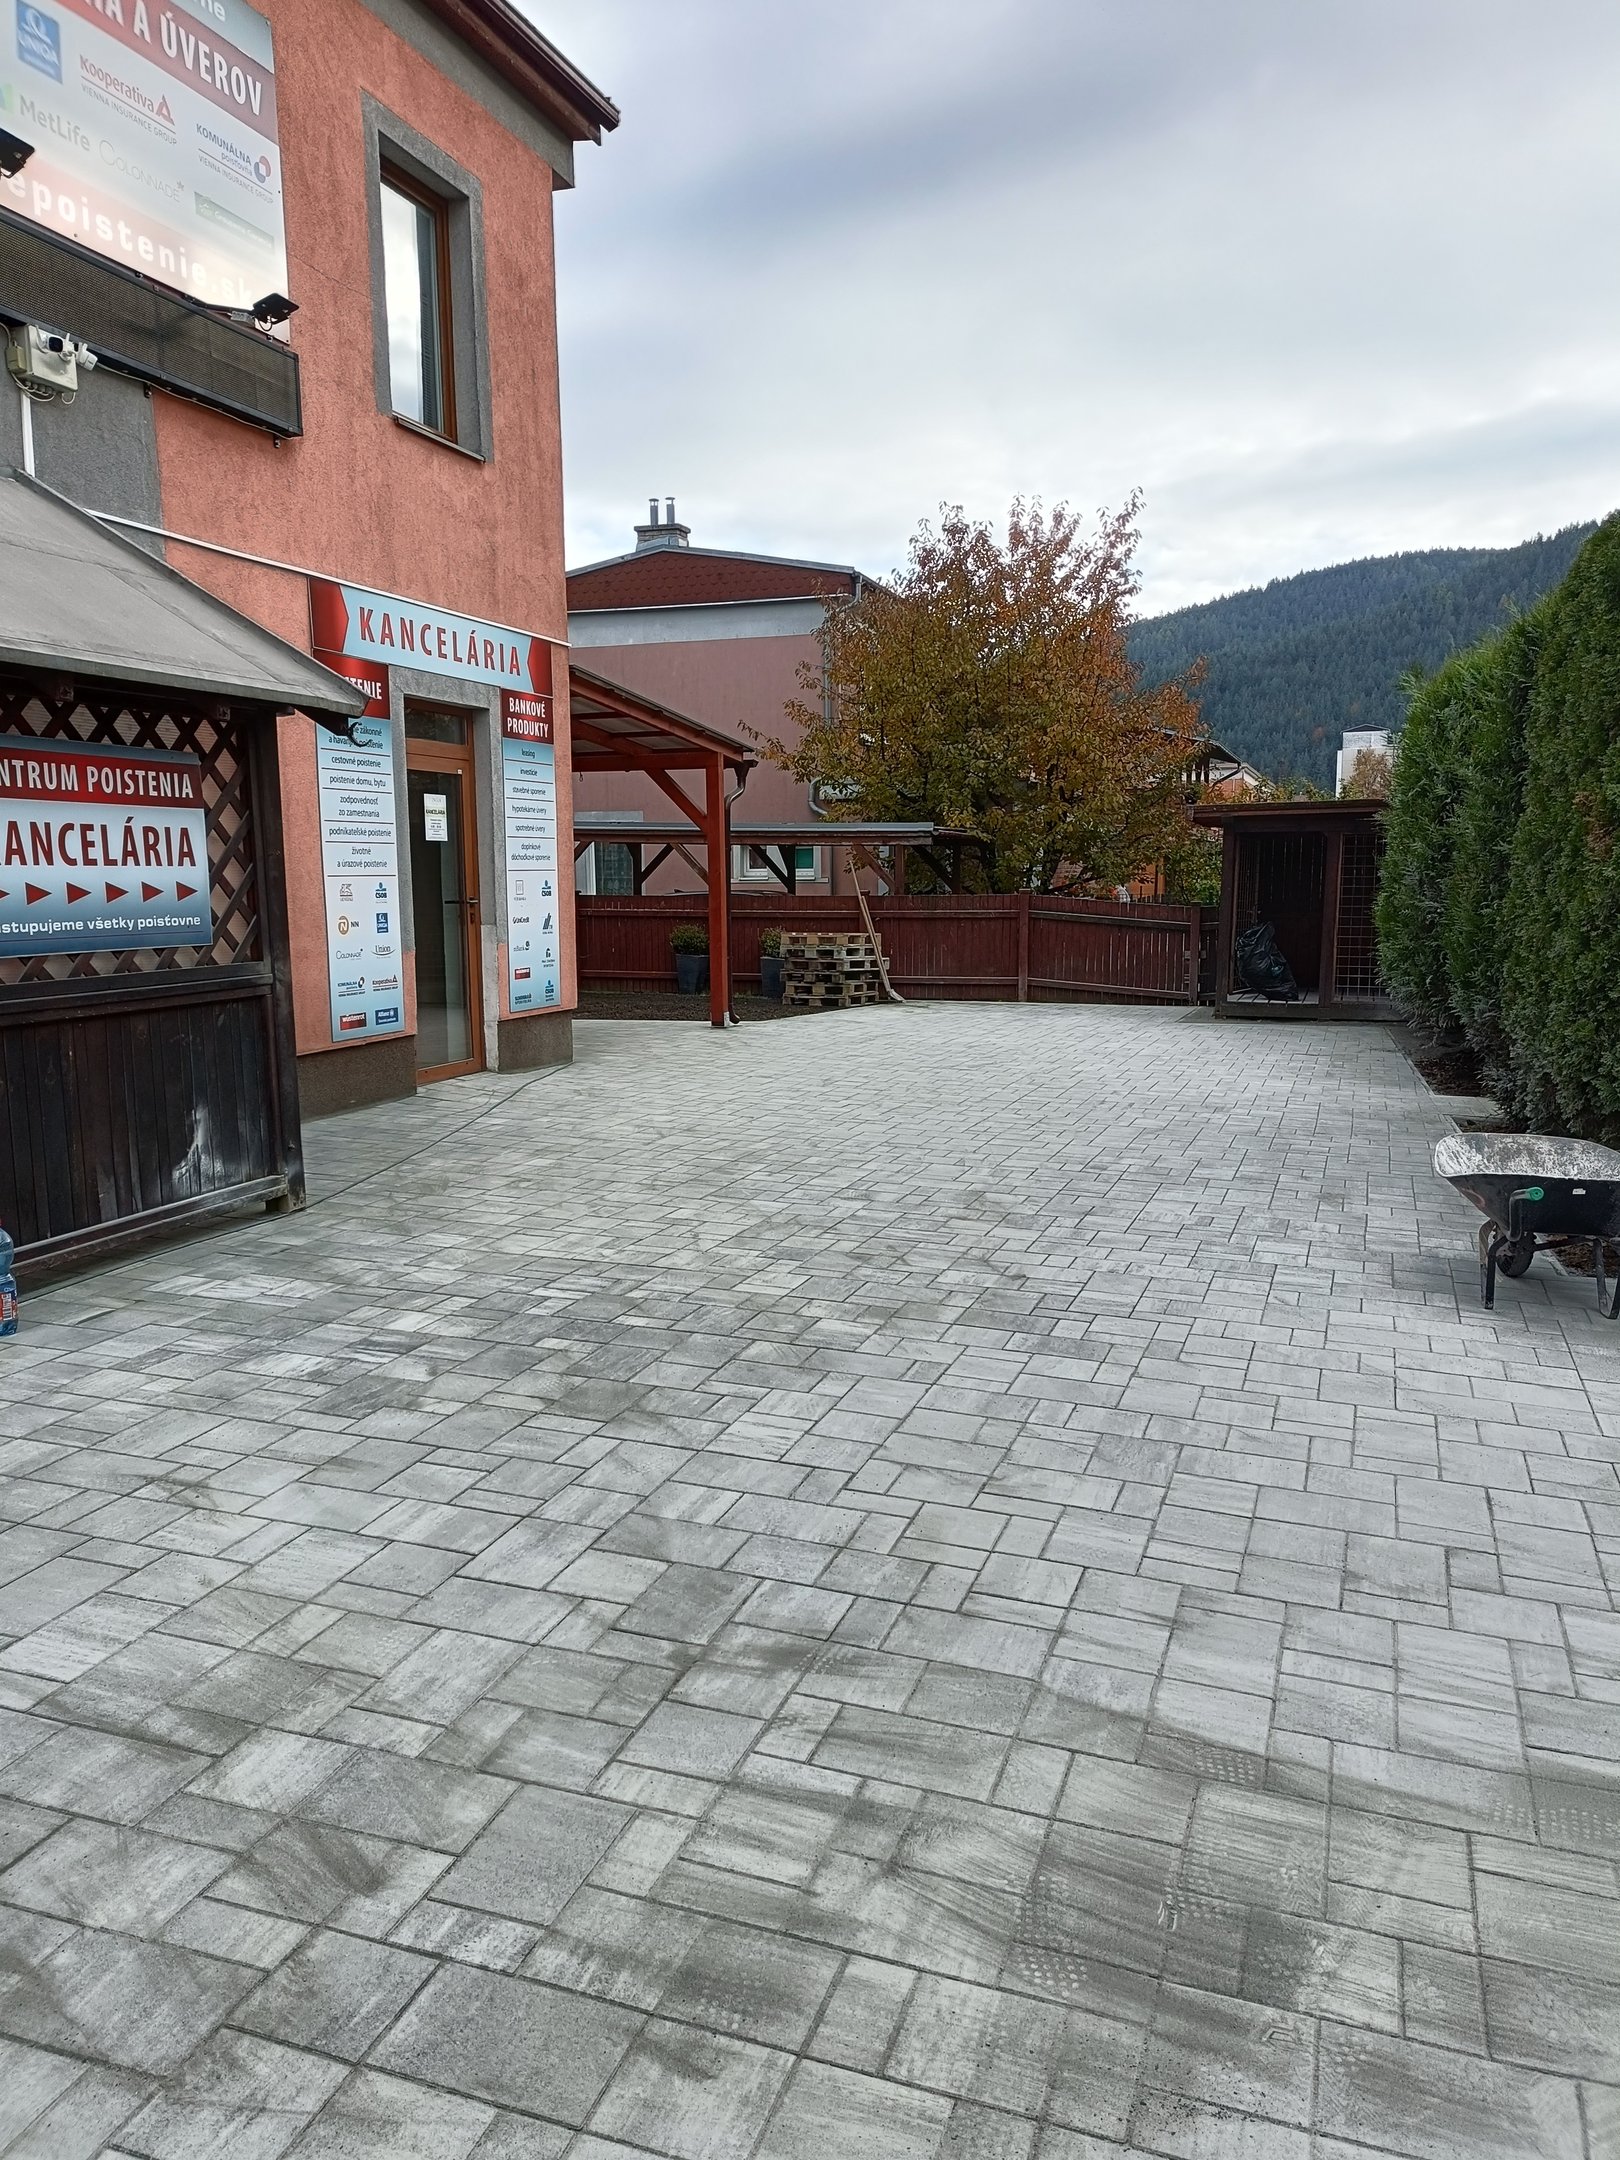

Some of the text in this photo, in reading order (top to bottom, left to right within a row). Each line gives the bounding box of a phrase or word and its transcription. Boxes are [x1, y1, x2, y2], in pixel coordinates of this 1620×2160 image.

[160, 11, 262, 116] ÚVEROV
[79, 53, 154, 113] Kooperativa
[19, 94, 90, 152] MetLife
[81, 84, 178, 146] VIENNA INSURANCE GROUP
[196, 123, 251, 166] KOMUNÁLNA
[359, 606, 521, 676] KANCELÁRIA
[509, 697, 546, 718] BANKOVÉ
[507, 717, 549, 738] PRODUKTY
[331, 756, 381, 768] cestovné poistenie
[87, 766, 193, 799] POISTENIA
[329, 774, 355, 784] poistenie
[374, 779, 386, 788] bytu
[346, 809, 380, 818] zamestnania
[0, 816, 197, 867] ANCELÁRIA
[368, 828, 391, 838] poistenie
[351, 846, 371, 855] životné
[363, 860, 387, 869] poistenie
[87, 916, 135, 931] všetky
[138, 914, 201, 929] poisťovne
